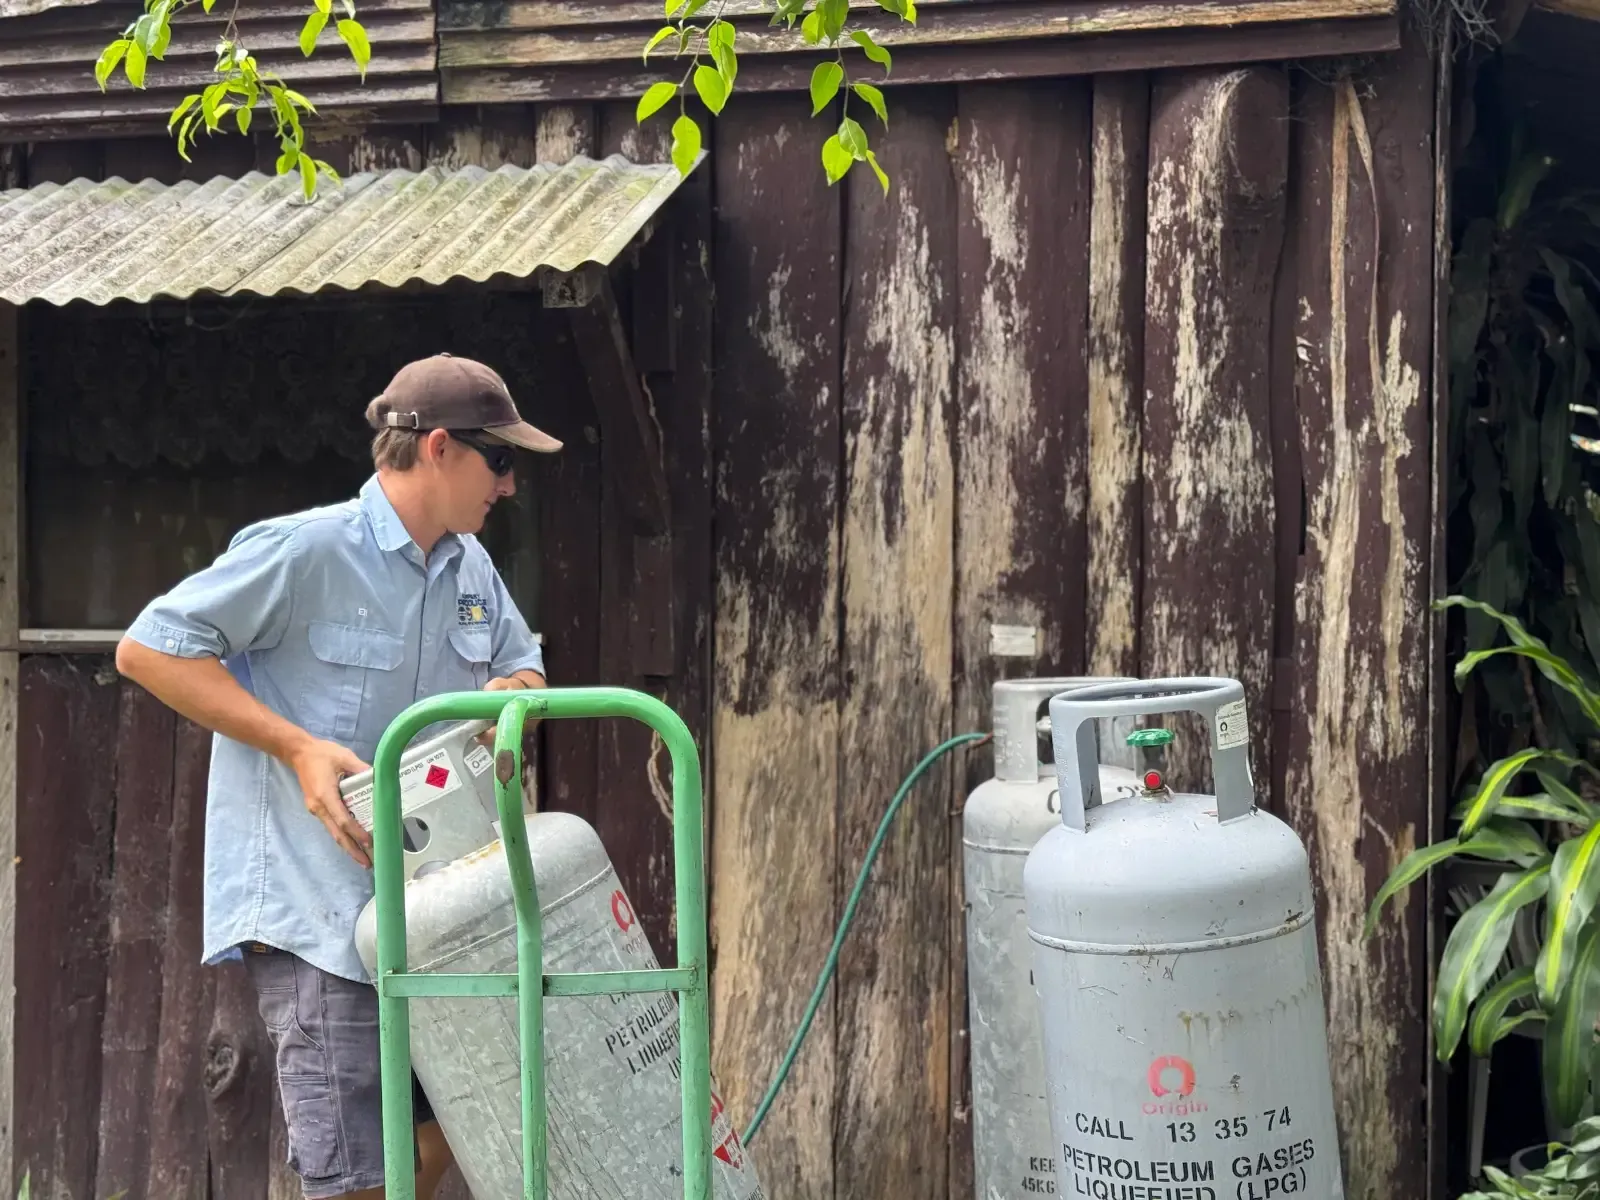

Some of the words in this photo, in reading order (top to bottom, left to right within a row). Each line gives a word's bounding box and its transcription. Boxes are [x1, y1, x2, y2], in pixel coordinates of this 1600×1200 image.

[1075, 1112, 1134, 1141] CALL
[1166, 1121, 1197, 1143] 13
[1214, 1116, 1248, 1140] 35
[1263, 1106, 1292, 1131] 74
[1142, 1100, 1209, 1116] Origin
[1062, 1143, 1214, 1182] PETROLEUM
[1232, 1138, 1315, 1178] GASES
[1021, 1176, 1055, 1194] 45KG
[1074, 1172, 1216, 1200] LIQUEFIED
[1236, 1166, 1306, 1200] (LPG)
